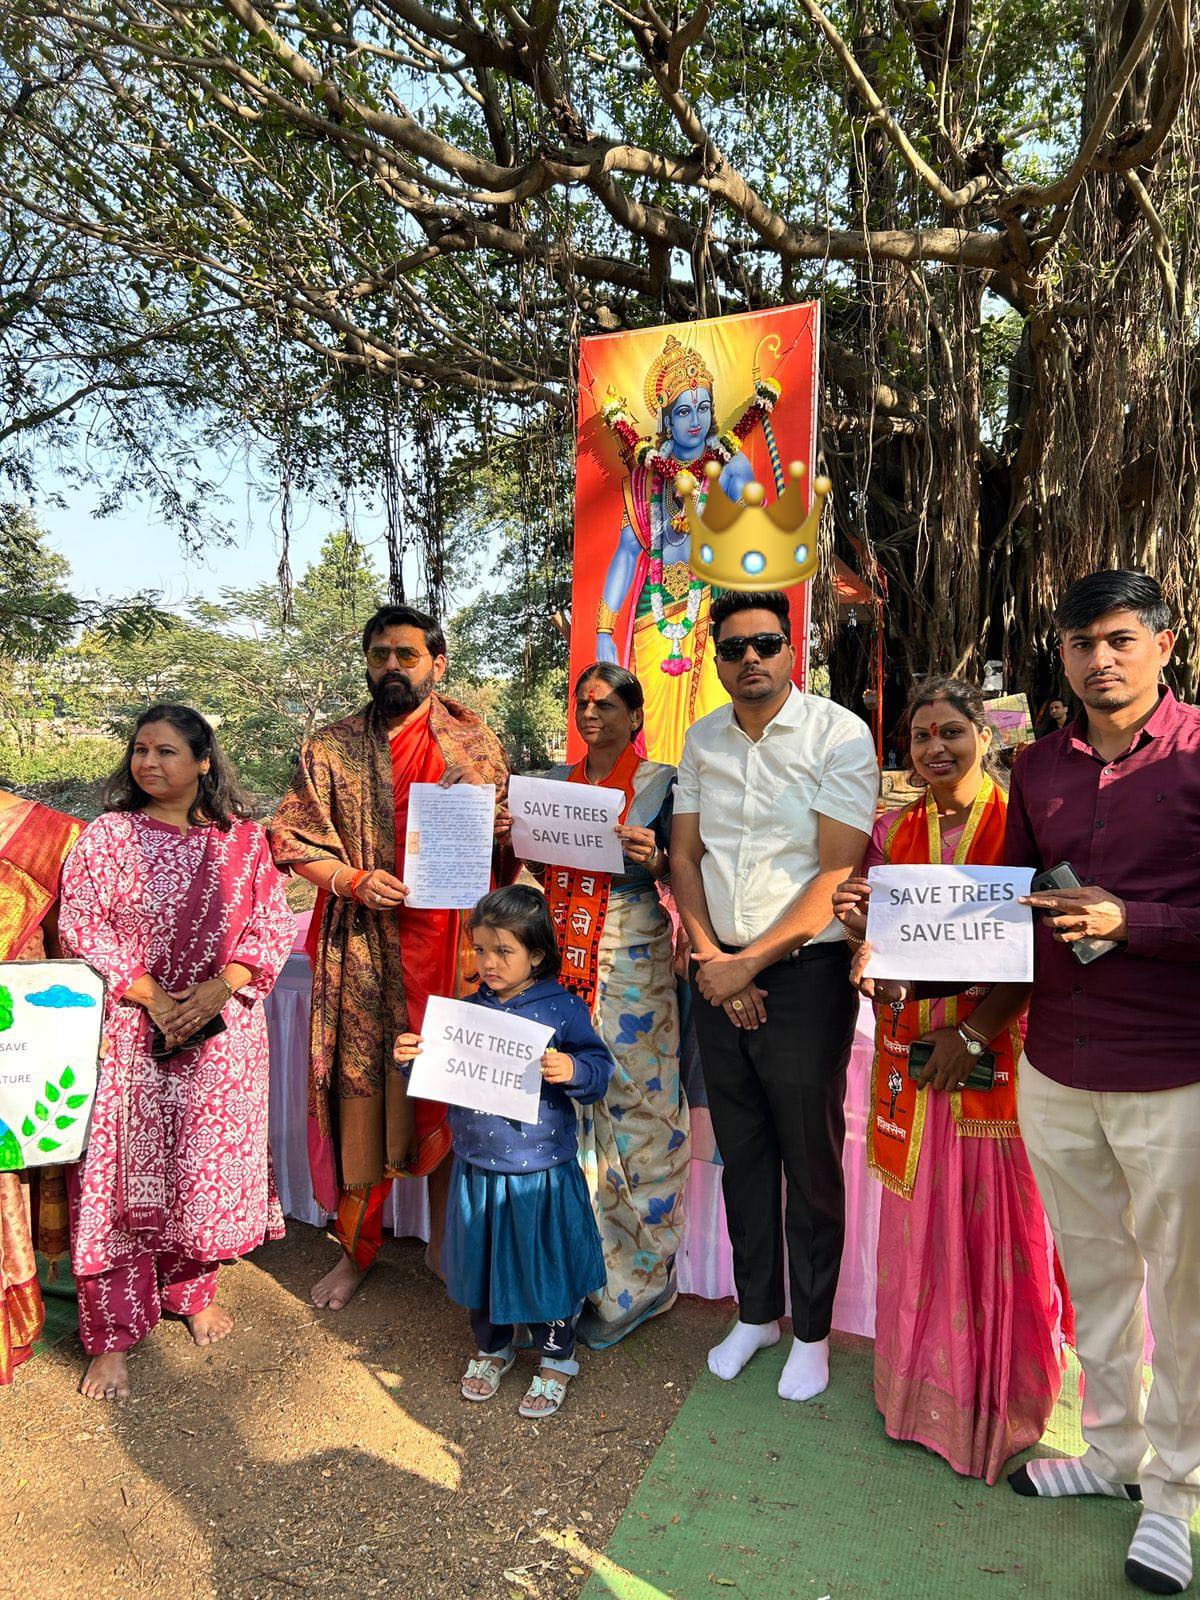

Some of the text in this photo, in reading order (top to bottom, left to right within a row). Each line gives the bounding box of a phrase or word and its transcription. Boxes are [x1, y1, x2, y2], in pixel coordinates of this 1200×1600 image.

[523, 801, 608, 823] SAVE TREES
[532, 829, 604, 848] SAVE LIFE
[890, 882, 1014, 906] SAVE TREES
[900, 921, 1005, 942] SAVE LIFE
[0, 1043, 28, 1052] SAVE
[443, 1025, 534, 1061] SAVE TREES
[0, 1074, 31, 1084] TURE
[445, 1058, 523, 1090] SAVE LIFE
